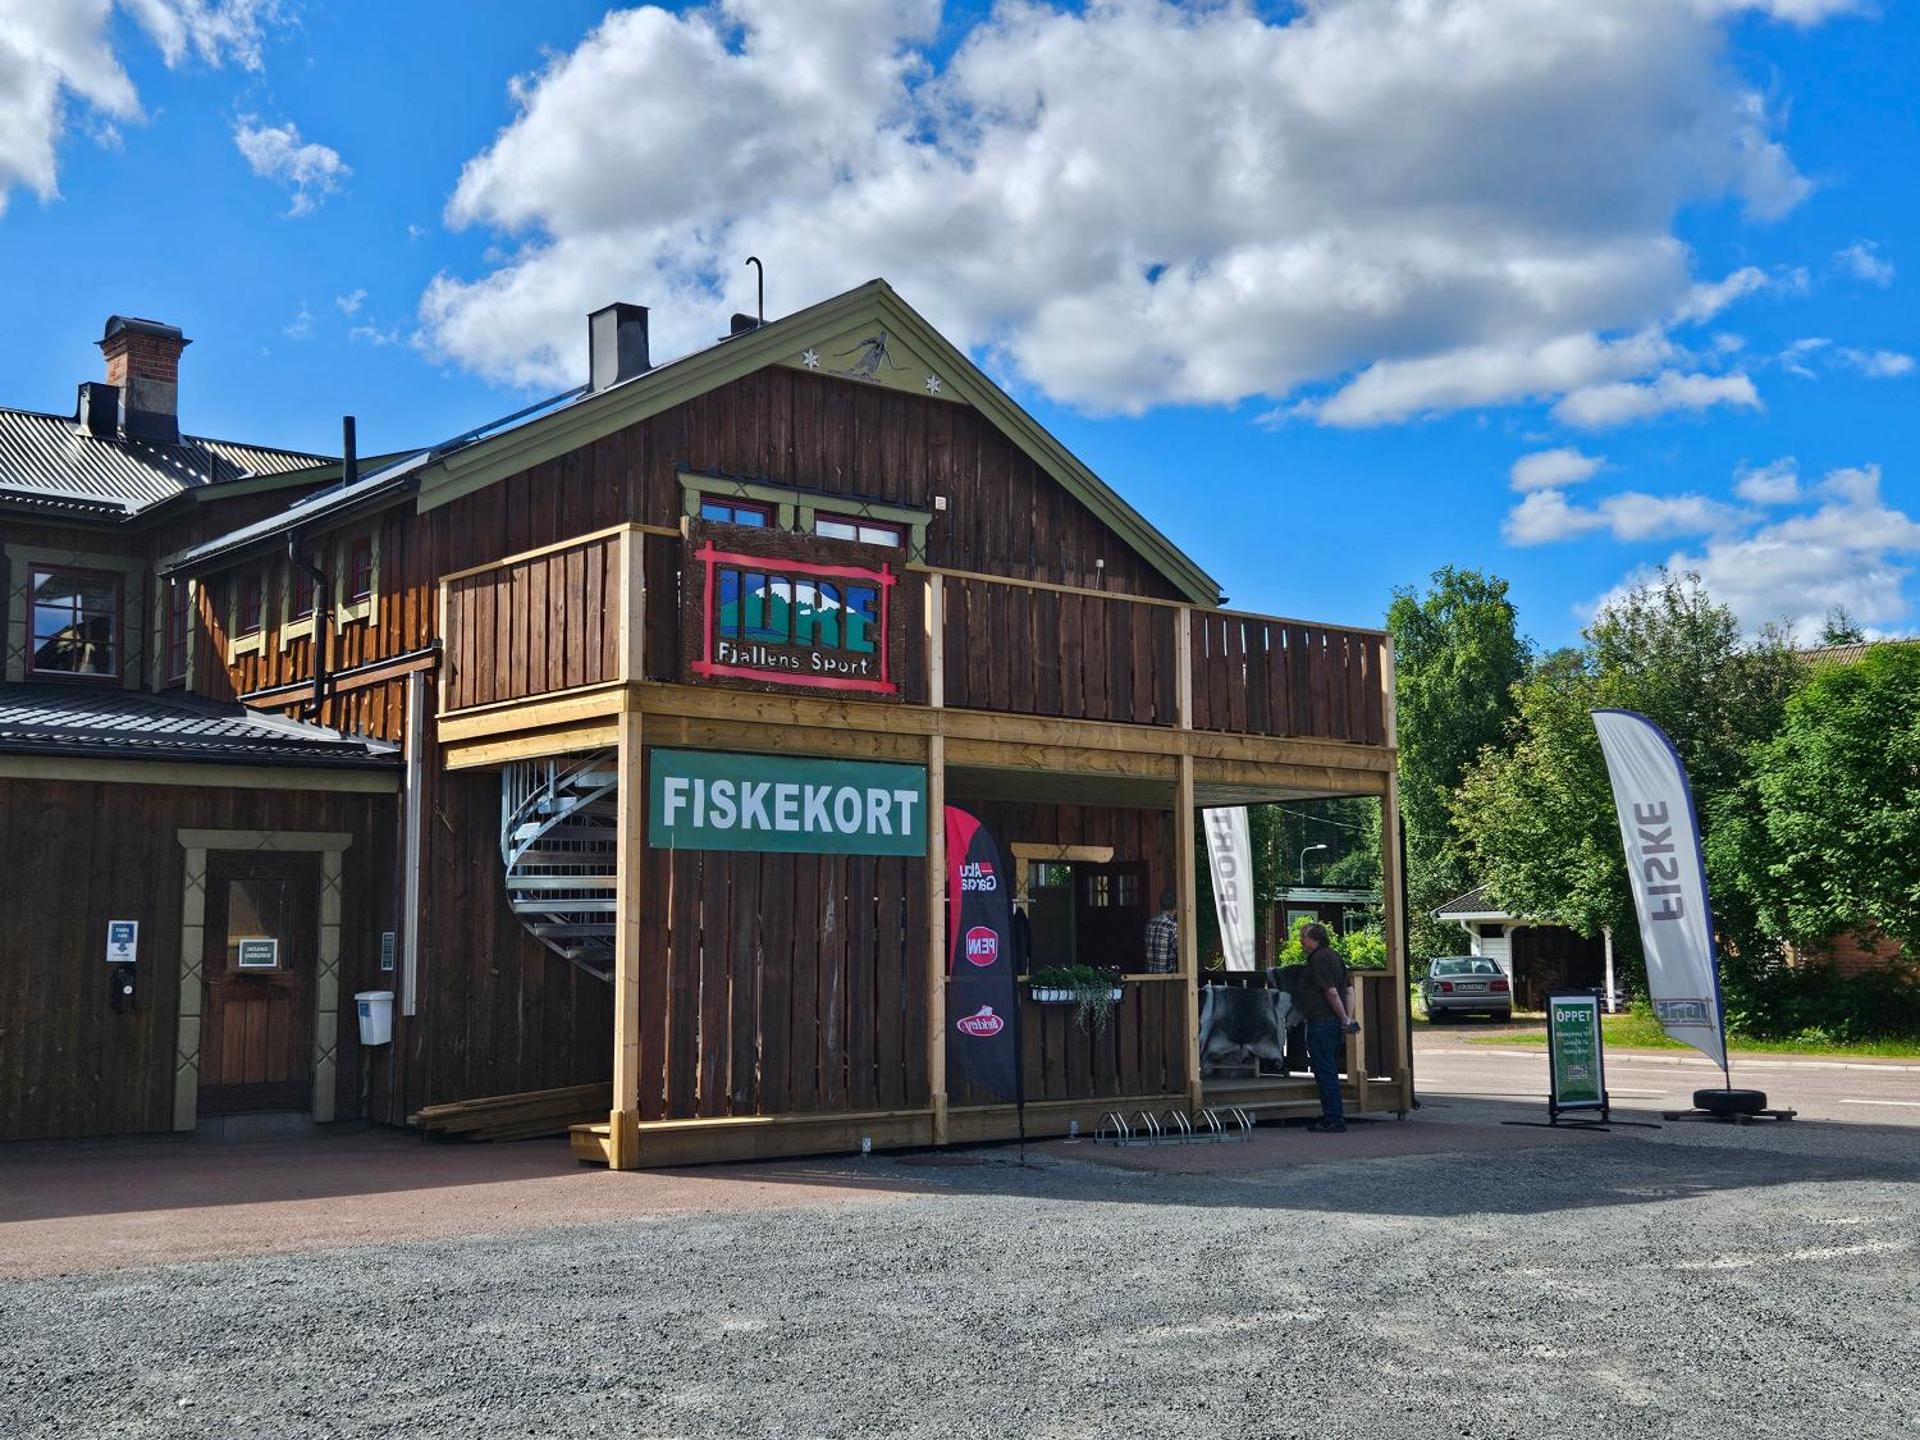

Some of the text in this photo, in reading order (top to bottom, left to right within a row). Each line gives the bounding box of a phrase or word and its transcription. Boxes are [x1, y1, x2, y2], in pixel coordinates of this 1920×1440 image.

[720, 569, 876, 653] IDRE
[812, 652, 869, 675] Sport
[663, 776, 919, 836] FISKEKORT
[1556, 1009, 1592, 1023] ÖPPET
